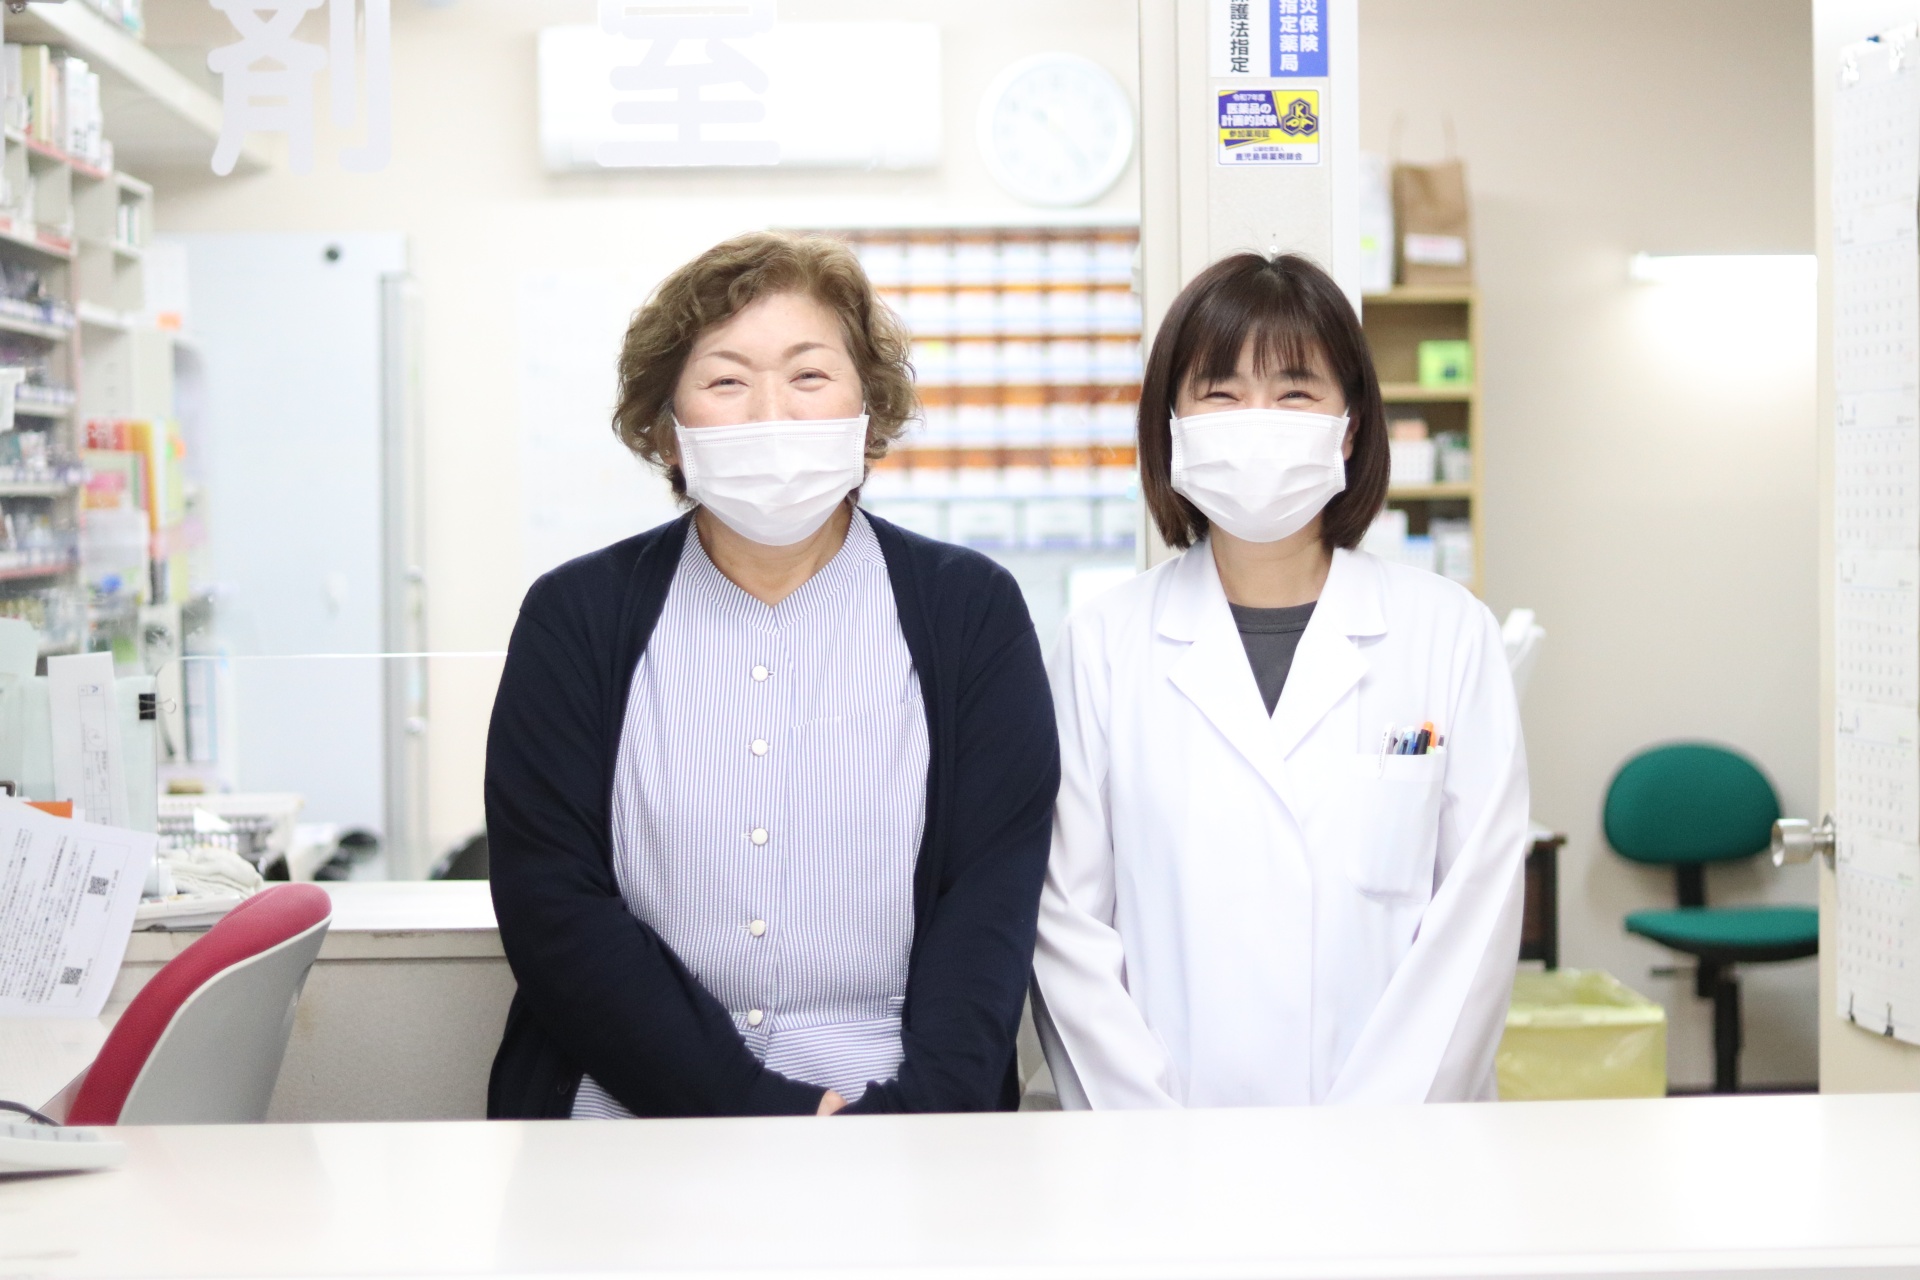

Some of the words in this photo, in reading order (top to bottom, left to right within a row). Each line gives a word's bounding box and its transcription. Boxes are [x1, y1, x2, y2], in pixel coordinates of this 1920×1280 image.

[1230, 0, 1249, 73] 護法指定
[1279, 0, 1299, 72] 指定薬局
[1221, 115, 1278, 127] 計画的試験
[1227, 103, 1272, 115] 医薬品の
